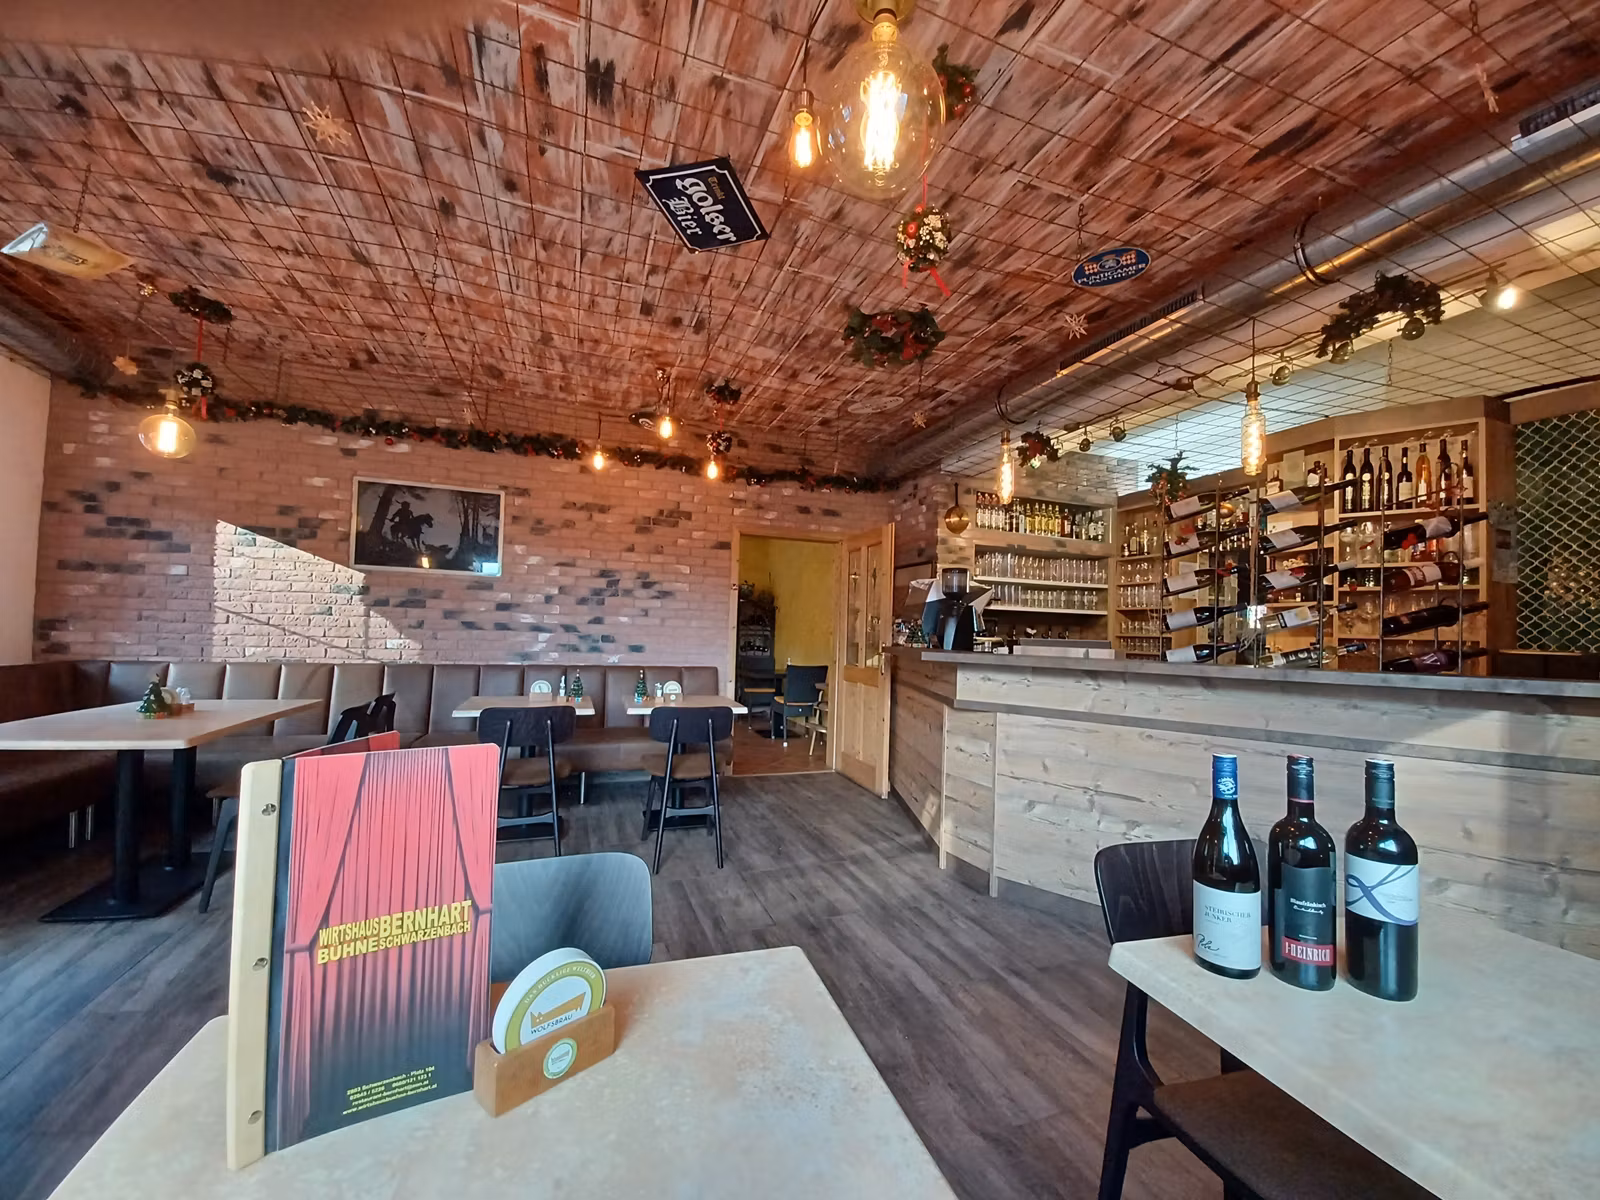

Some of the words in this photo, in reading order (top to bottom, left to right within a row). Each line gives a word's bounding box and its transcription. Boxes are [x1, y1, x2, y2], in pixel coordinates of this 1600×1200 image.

[661, 196, 703, 235] Bier
[319, 917, 380, 947] WIRTSHAUS
[379, 899, 472, 938] BERNHART
[379, 920, 471, 950] SCHWARZENBACH
